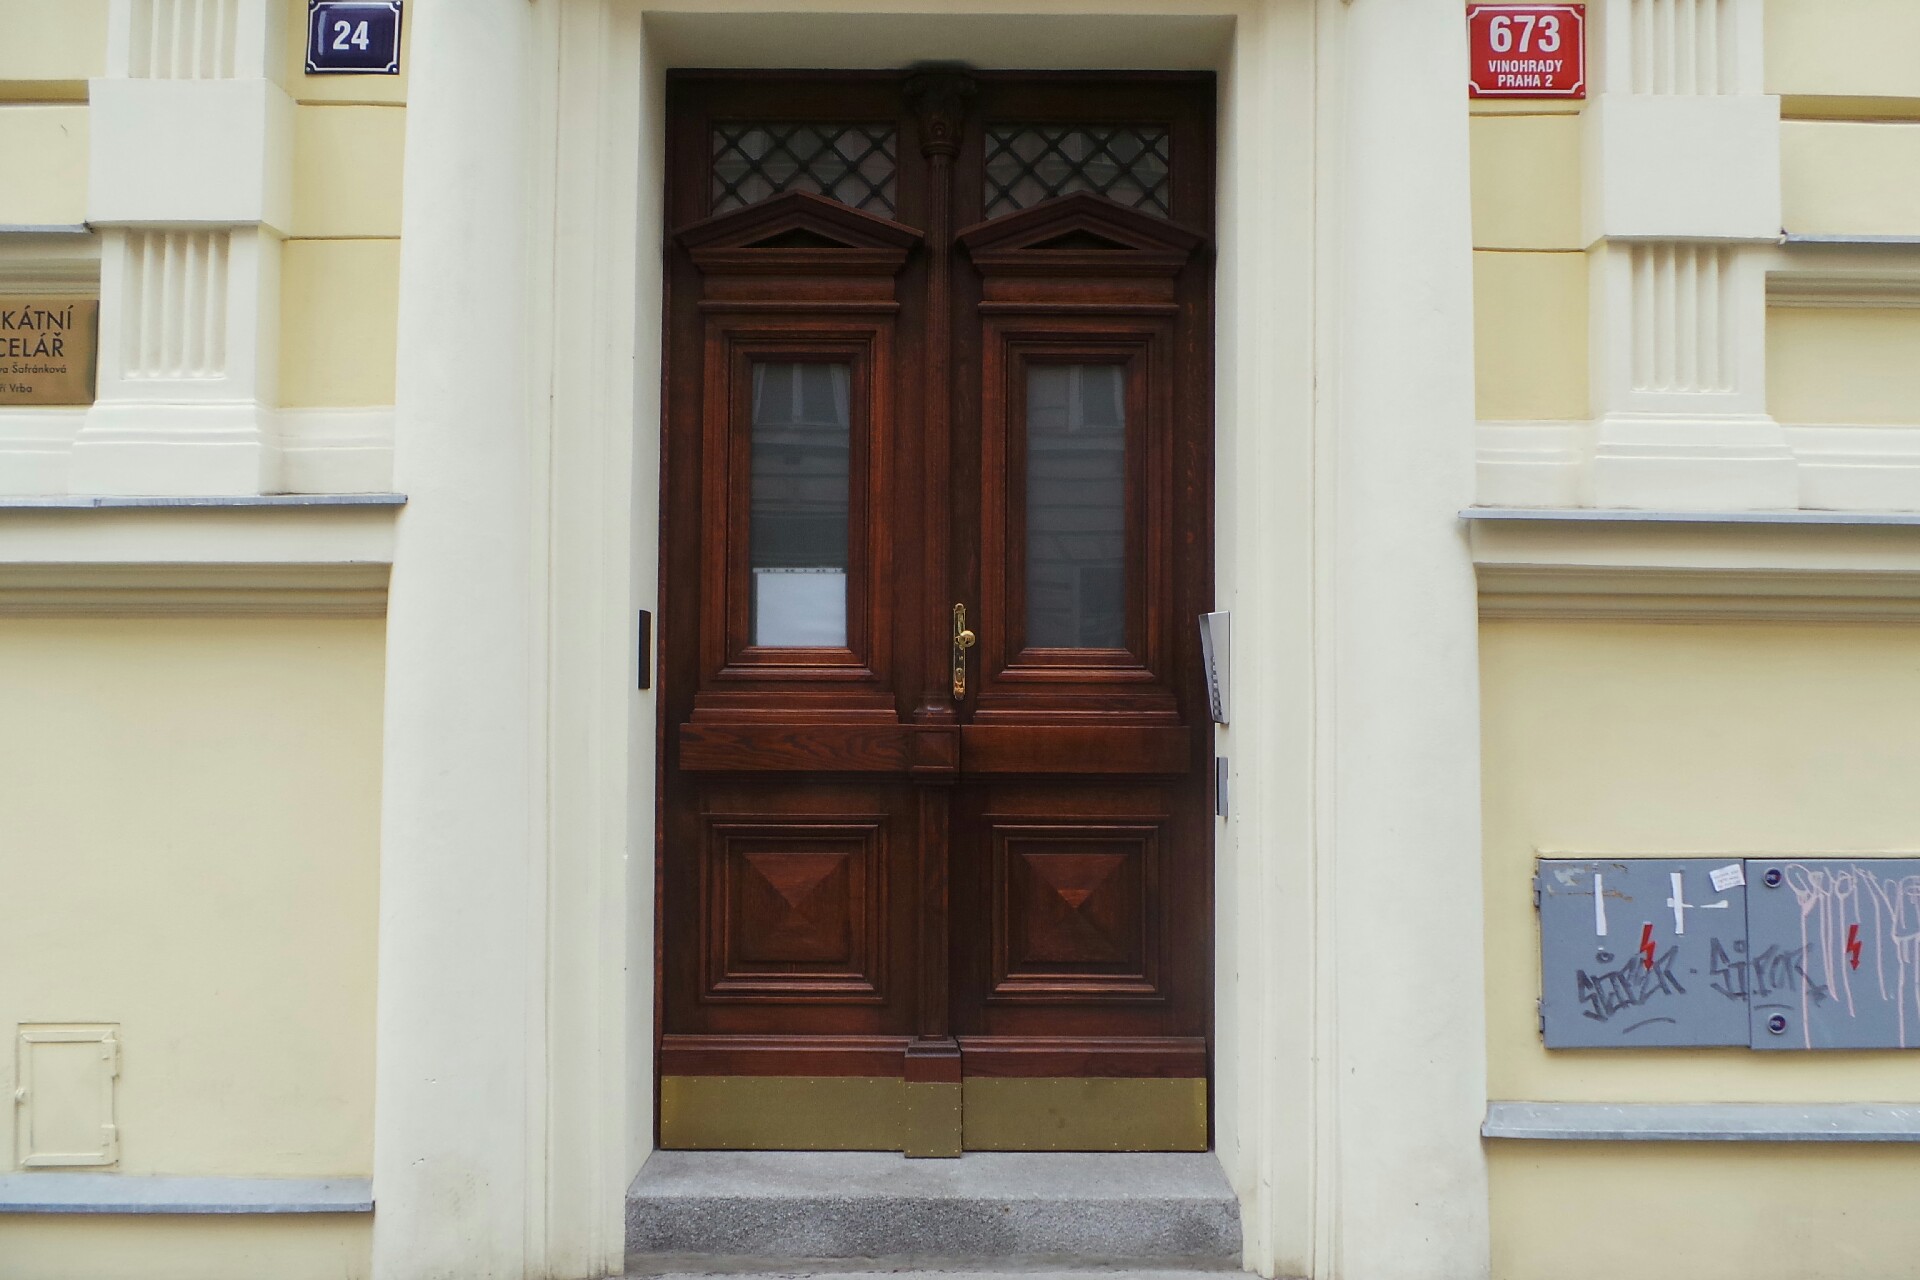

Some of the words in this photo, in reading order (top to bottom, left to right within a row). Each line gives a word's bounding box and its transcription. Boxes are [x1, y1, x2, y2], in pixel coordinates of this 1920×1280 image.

[332, 20, 369, 50] 24
[1489, 15, 1561, 53] 673
[1488, 59, 1563, 73] VINOHRADY
[1498, 74, 1541, 87] PRAHA
[1545, 74, 1553, 87] 2
[2, 305, 74, 330] KÁTNÍ
[9, 383, 33, 393] Vrba
